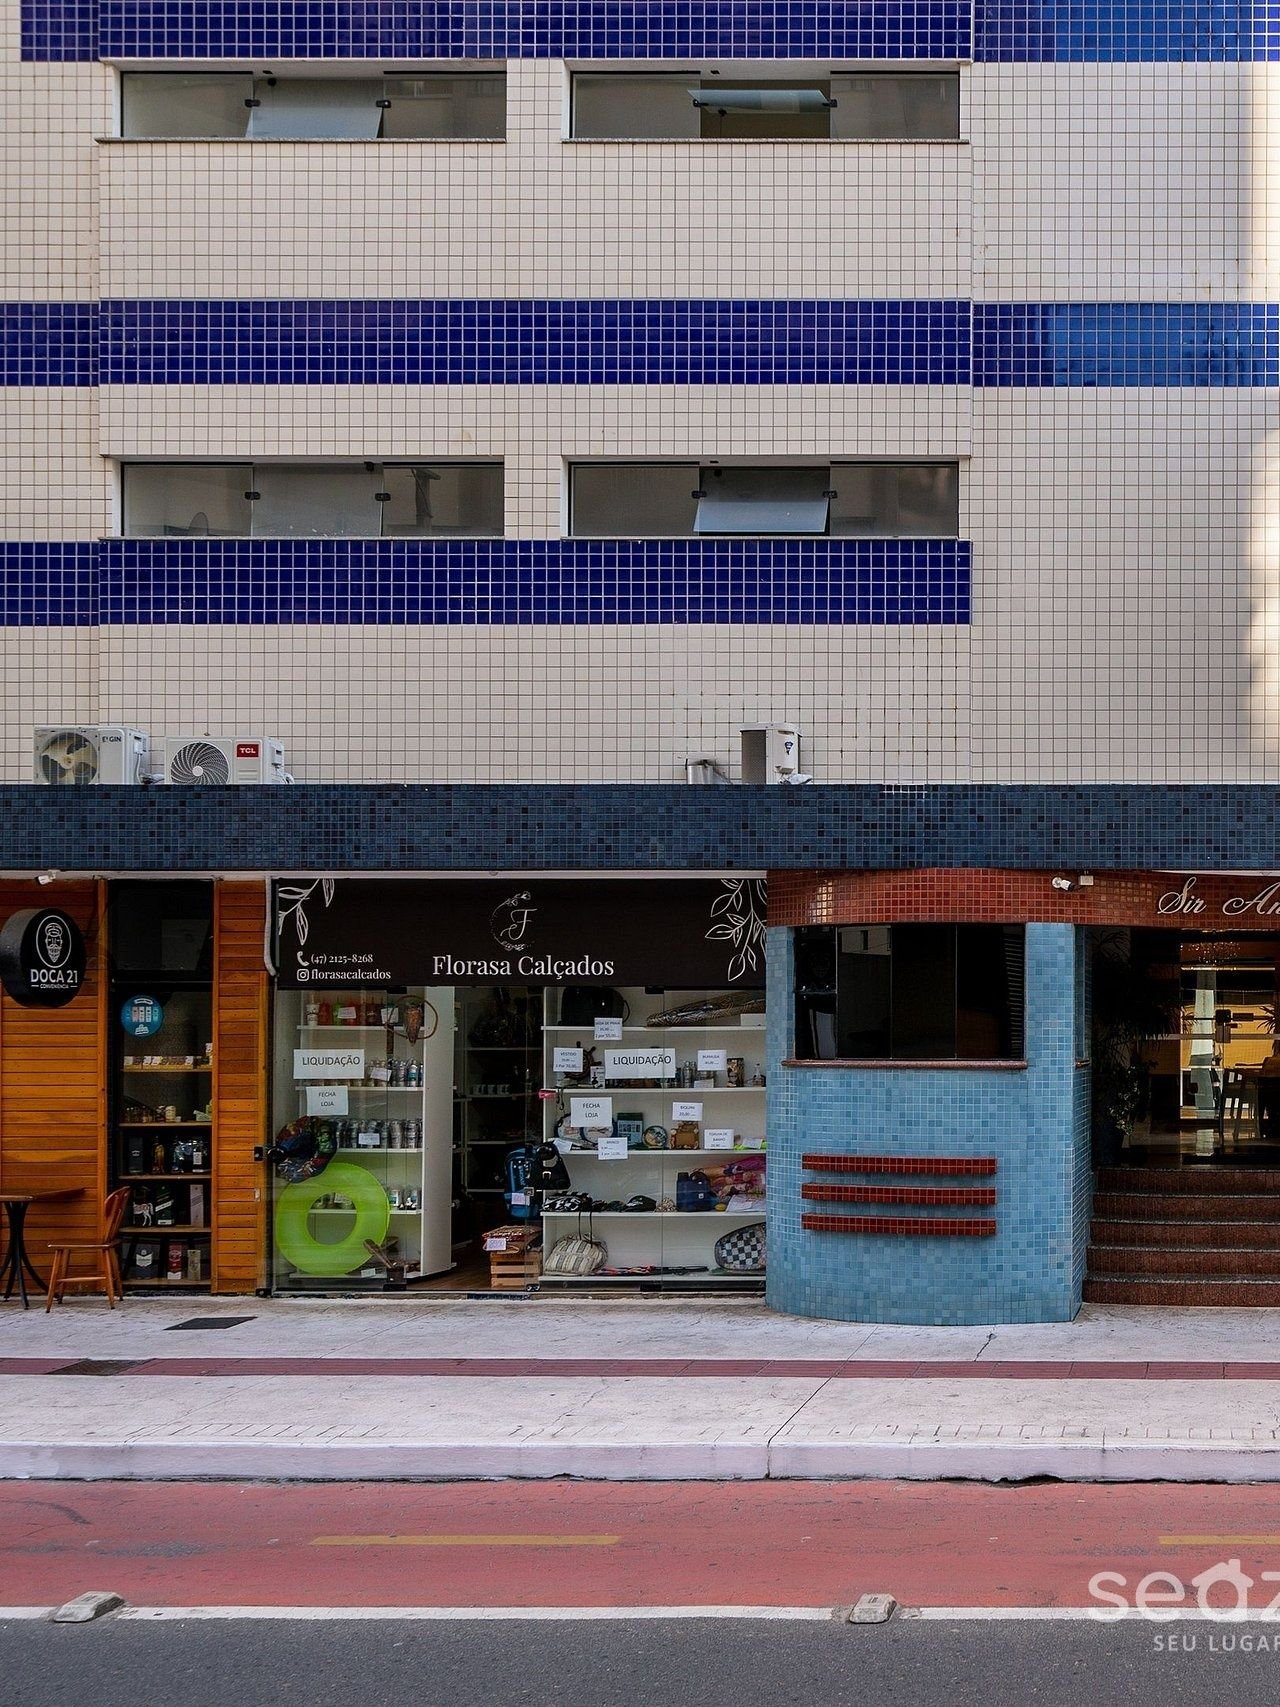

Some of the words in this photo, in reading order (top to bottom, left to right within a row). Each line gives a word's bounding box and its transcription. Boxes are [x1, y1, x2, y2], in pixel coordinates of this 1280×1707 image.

[1157, 876, 1207, 914] Sir
[310, 953, 328, 965] (47)
[328, 953, 374, 965] 2125-8268
[432, 954, 512, 976] Florasa
[518, 954, 615, 980] Calçados
[30, 969, 65, 983] DOCA
[66, 969, 78, 983] 21
[311, 968, 392, 980] florasacalcados
[302, 1055, 361, 1067] LIQUIDAÇÃO
[613, 1054, 672, 1066] LIQUIDAÇÃO
